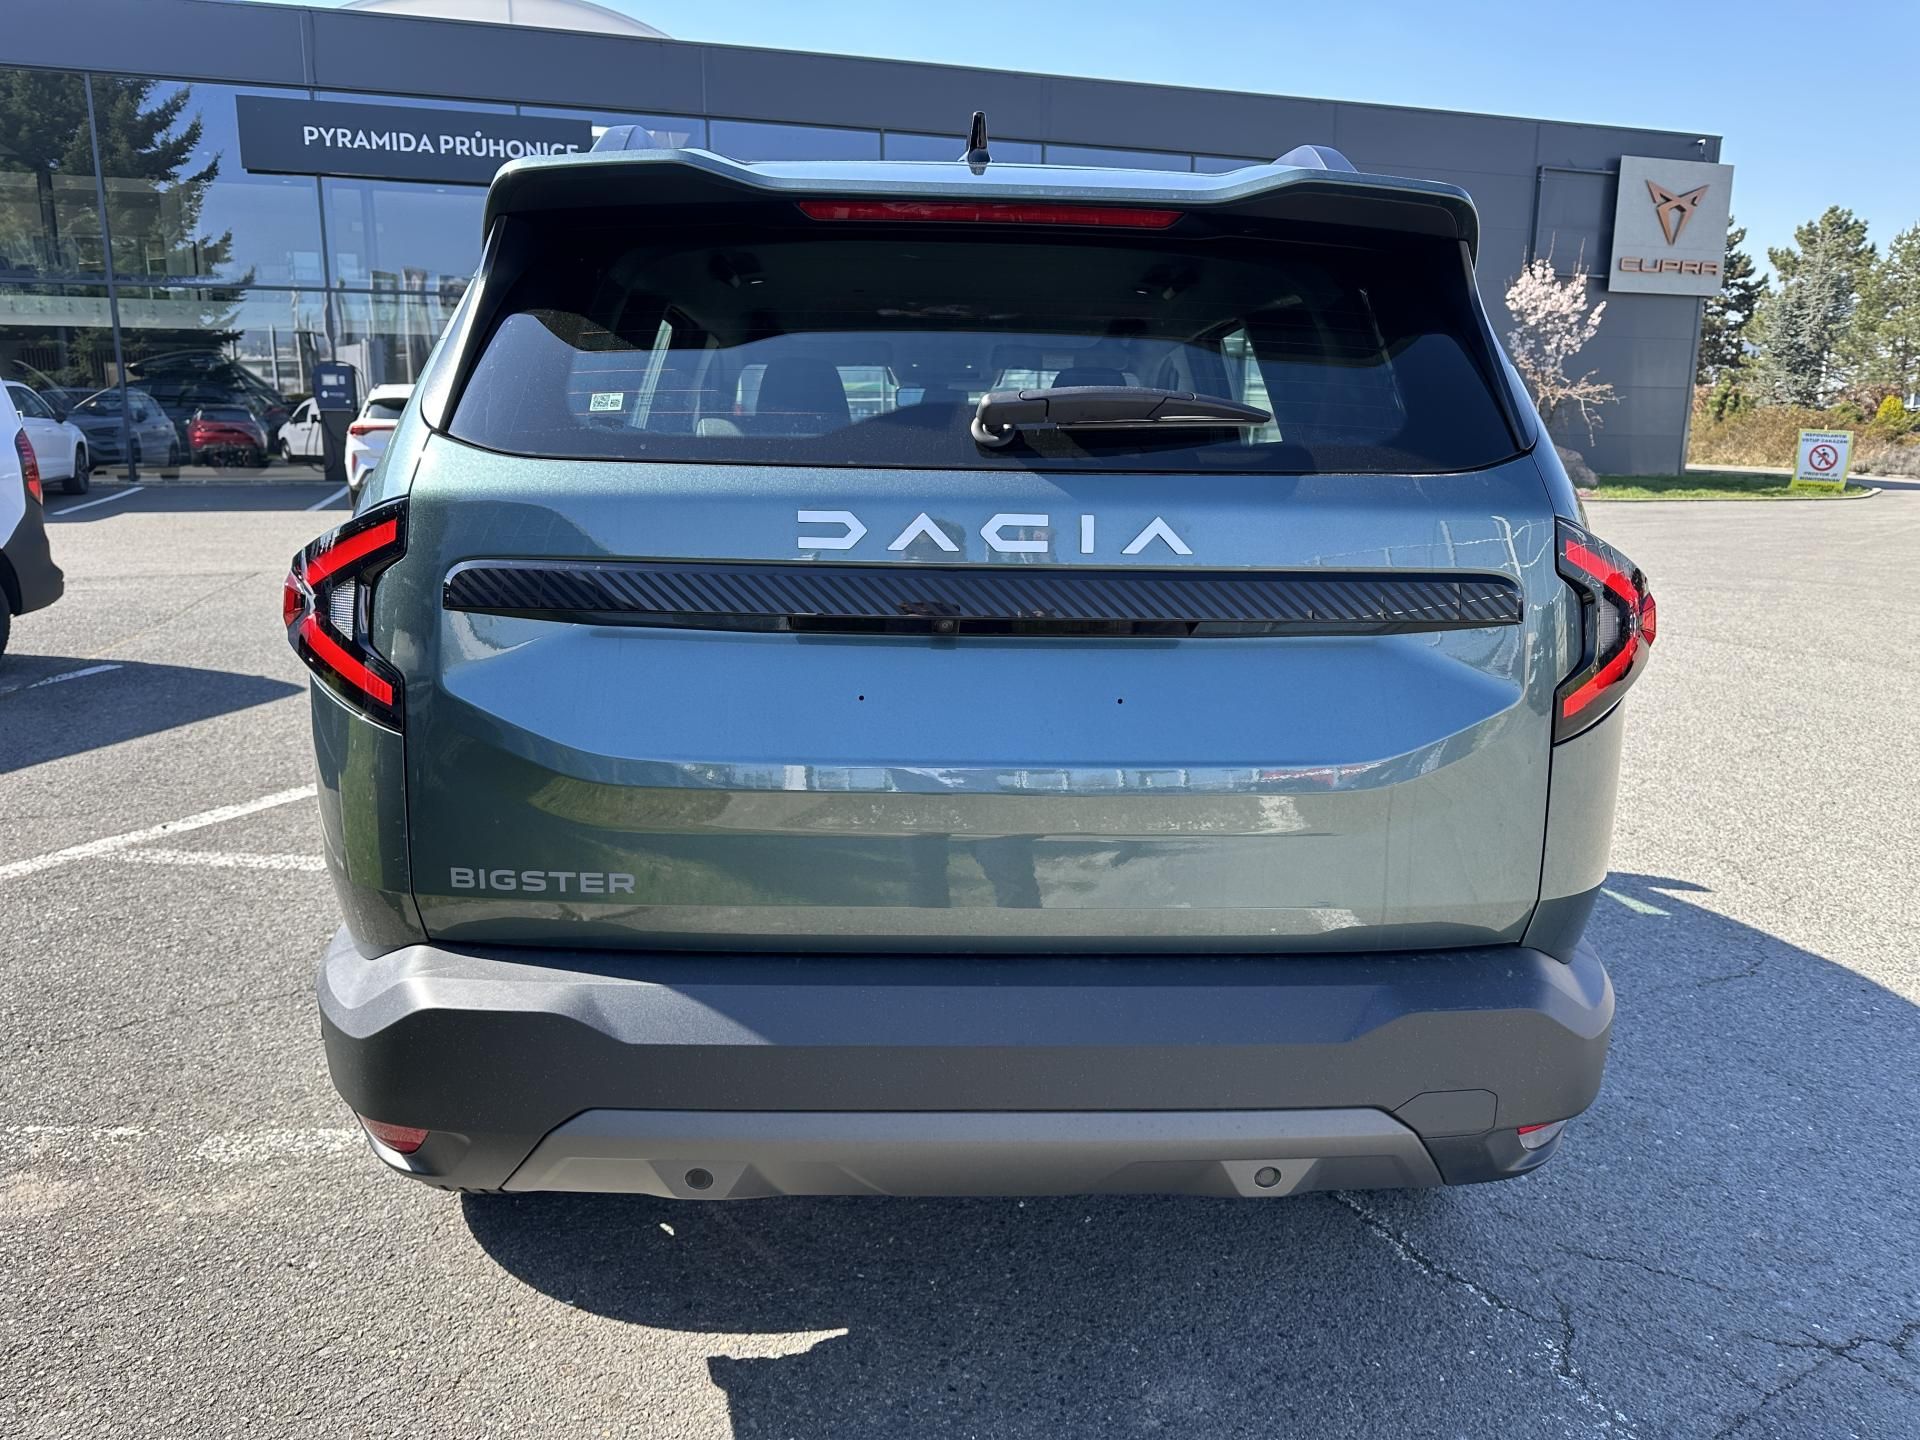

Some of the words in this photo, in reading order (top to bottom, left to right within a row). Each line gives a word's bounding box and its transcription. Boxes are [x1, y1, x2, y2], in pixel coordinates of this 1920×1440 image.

[303, 125, 435, 154] PYRAMIDA
[1619, 256, 1718, 276] CUPRA
[797, 510, 1193, 555] DACIA
[450, 866, 636, 895] BIGSTER
